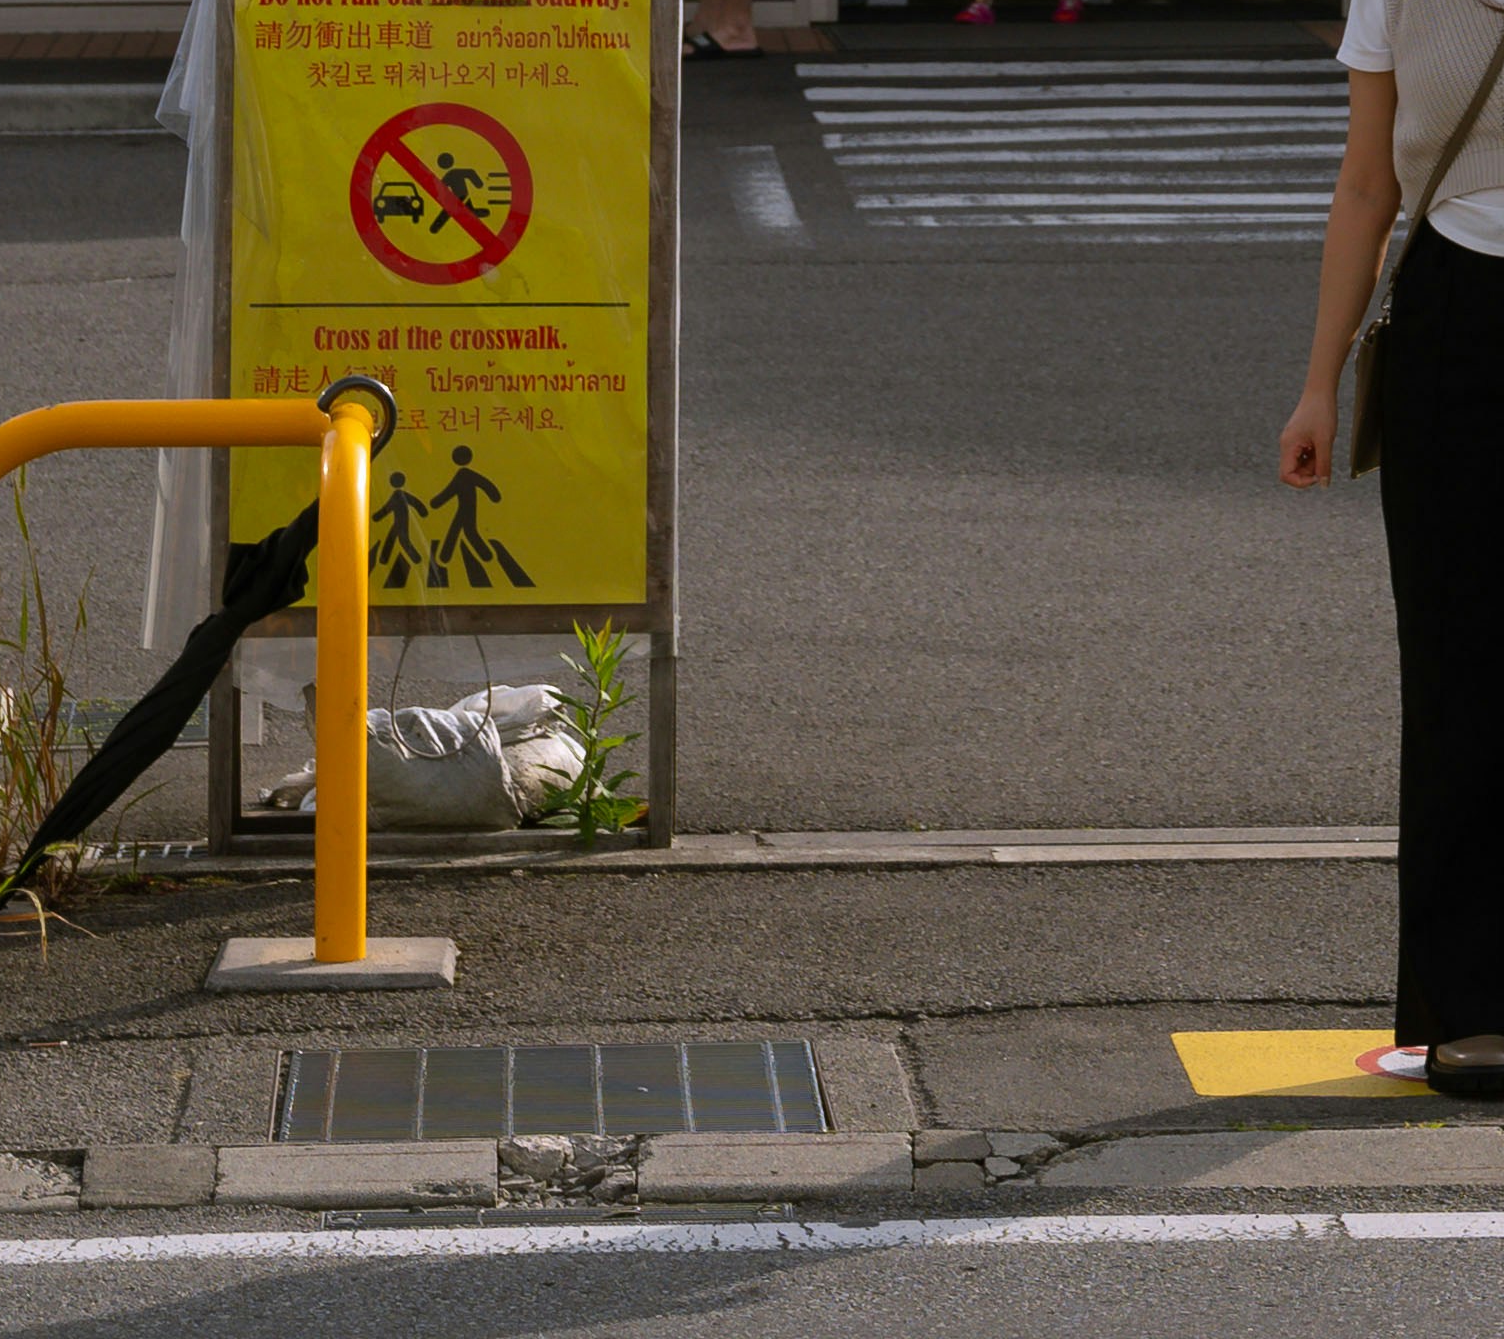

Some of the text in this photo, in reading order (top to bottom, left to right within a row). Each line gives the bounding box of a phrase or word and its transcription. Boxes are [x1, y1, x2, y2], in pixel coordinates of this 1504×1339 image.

[255, 19, 434, 51] 請勿衝出車道
[308, 61, 579, 89] 찻길로 뛰쳐나오지 마세요.
[314, 326, 568, 351] Cross at the crosswalk.
[438, 407, 481, 431] 건너
[490, 406, 564, 431] 주세요.
